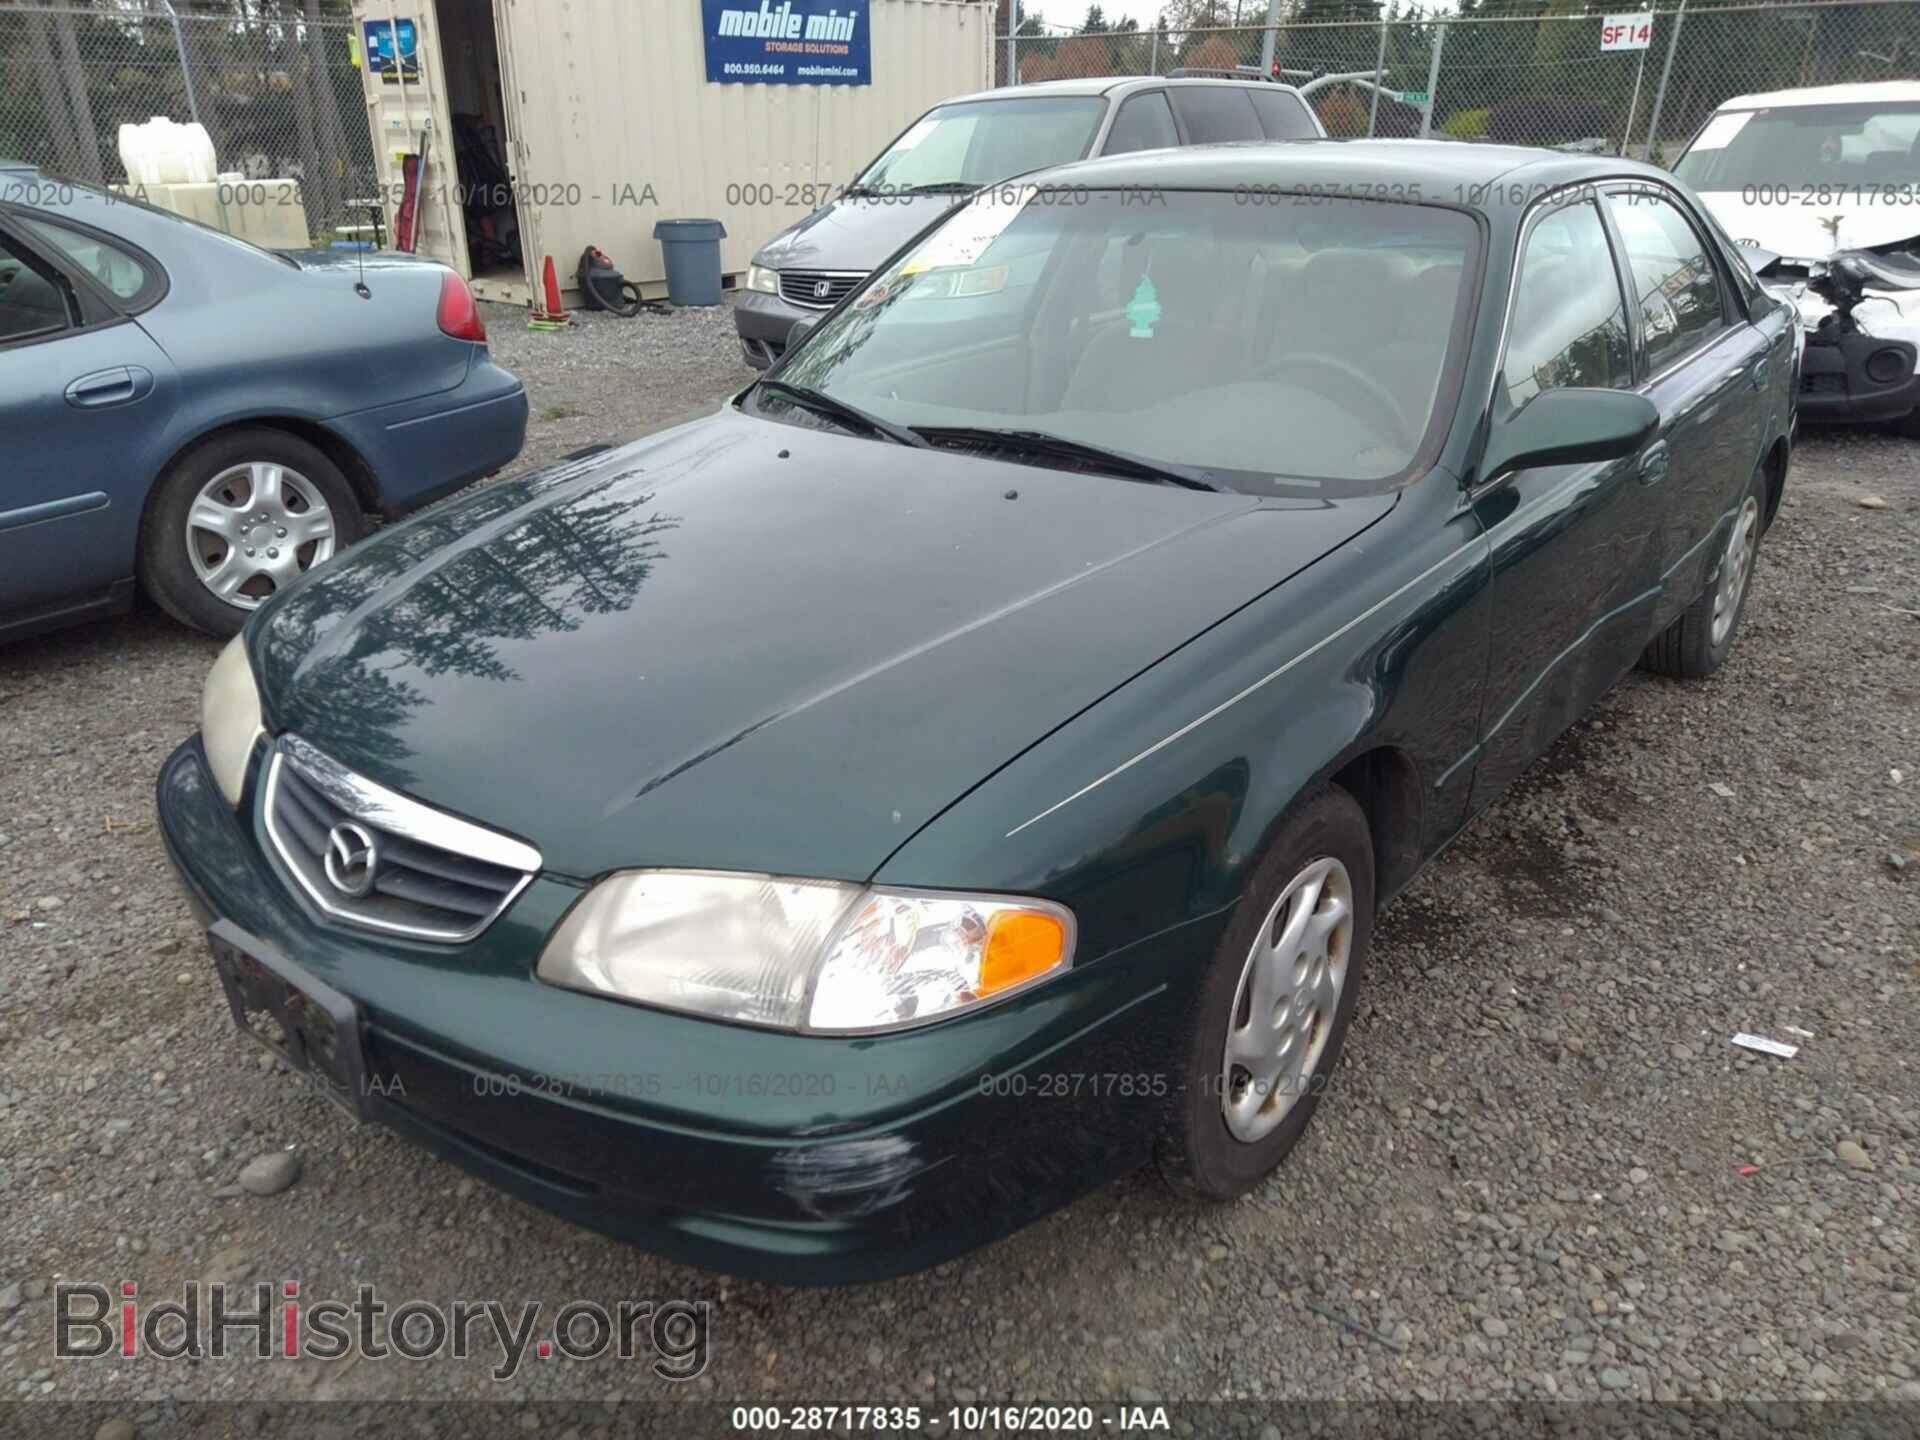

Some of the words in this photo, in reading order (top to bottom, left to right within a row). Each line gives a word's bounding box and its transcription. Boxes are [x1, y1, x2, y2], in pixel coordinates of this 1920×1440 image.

[718, 0, 802, 39] mobile
[805, 9, 856, 41] mini
[1603, 24, 1649, 44] SF14
[765, 42, 803, 53] STORAGE
[805, 44, 849, 55] SOLUTIONS
[724, 63, 784, 75] 800.950.6464
[797, 65, 858, 76] mobilemini.com
